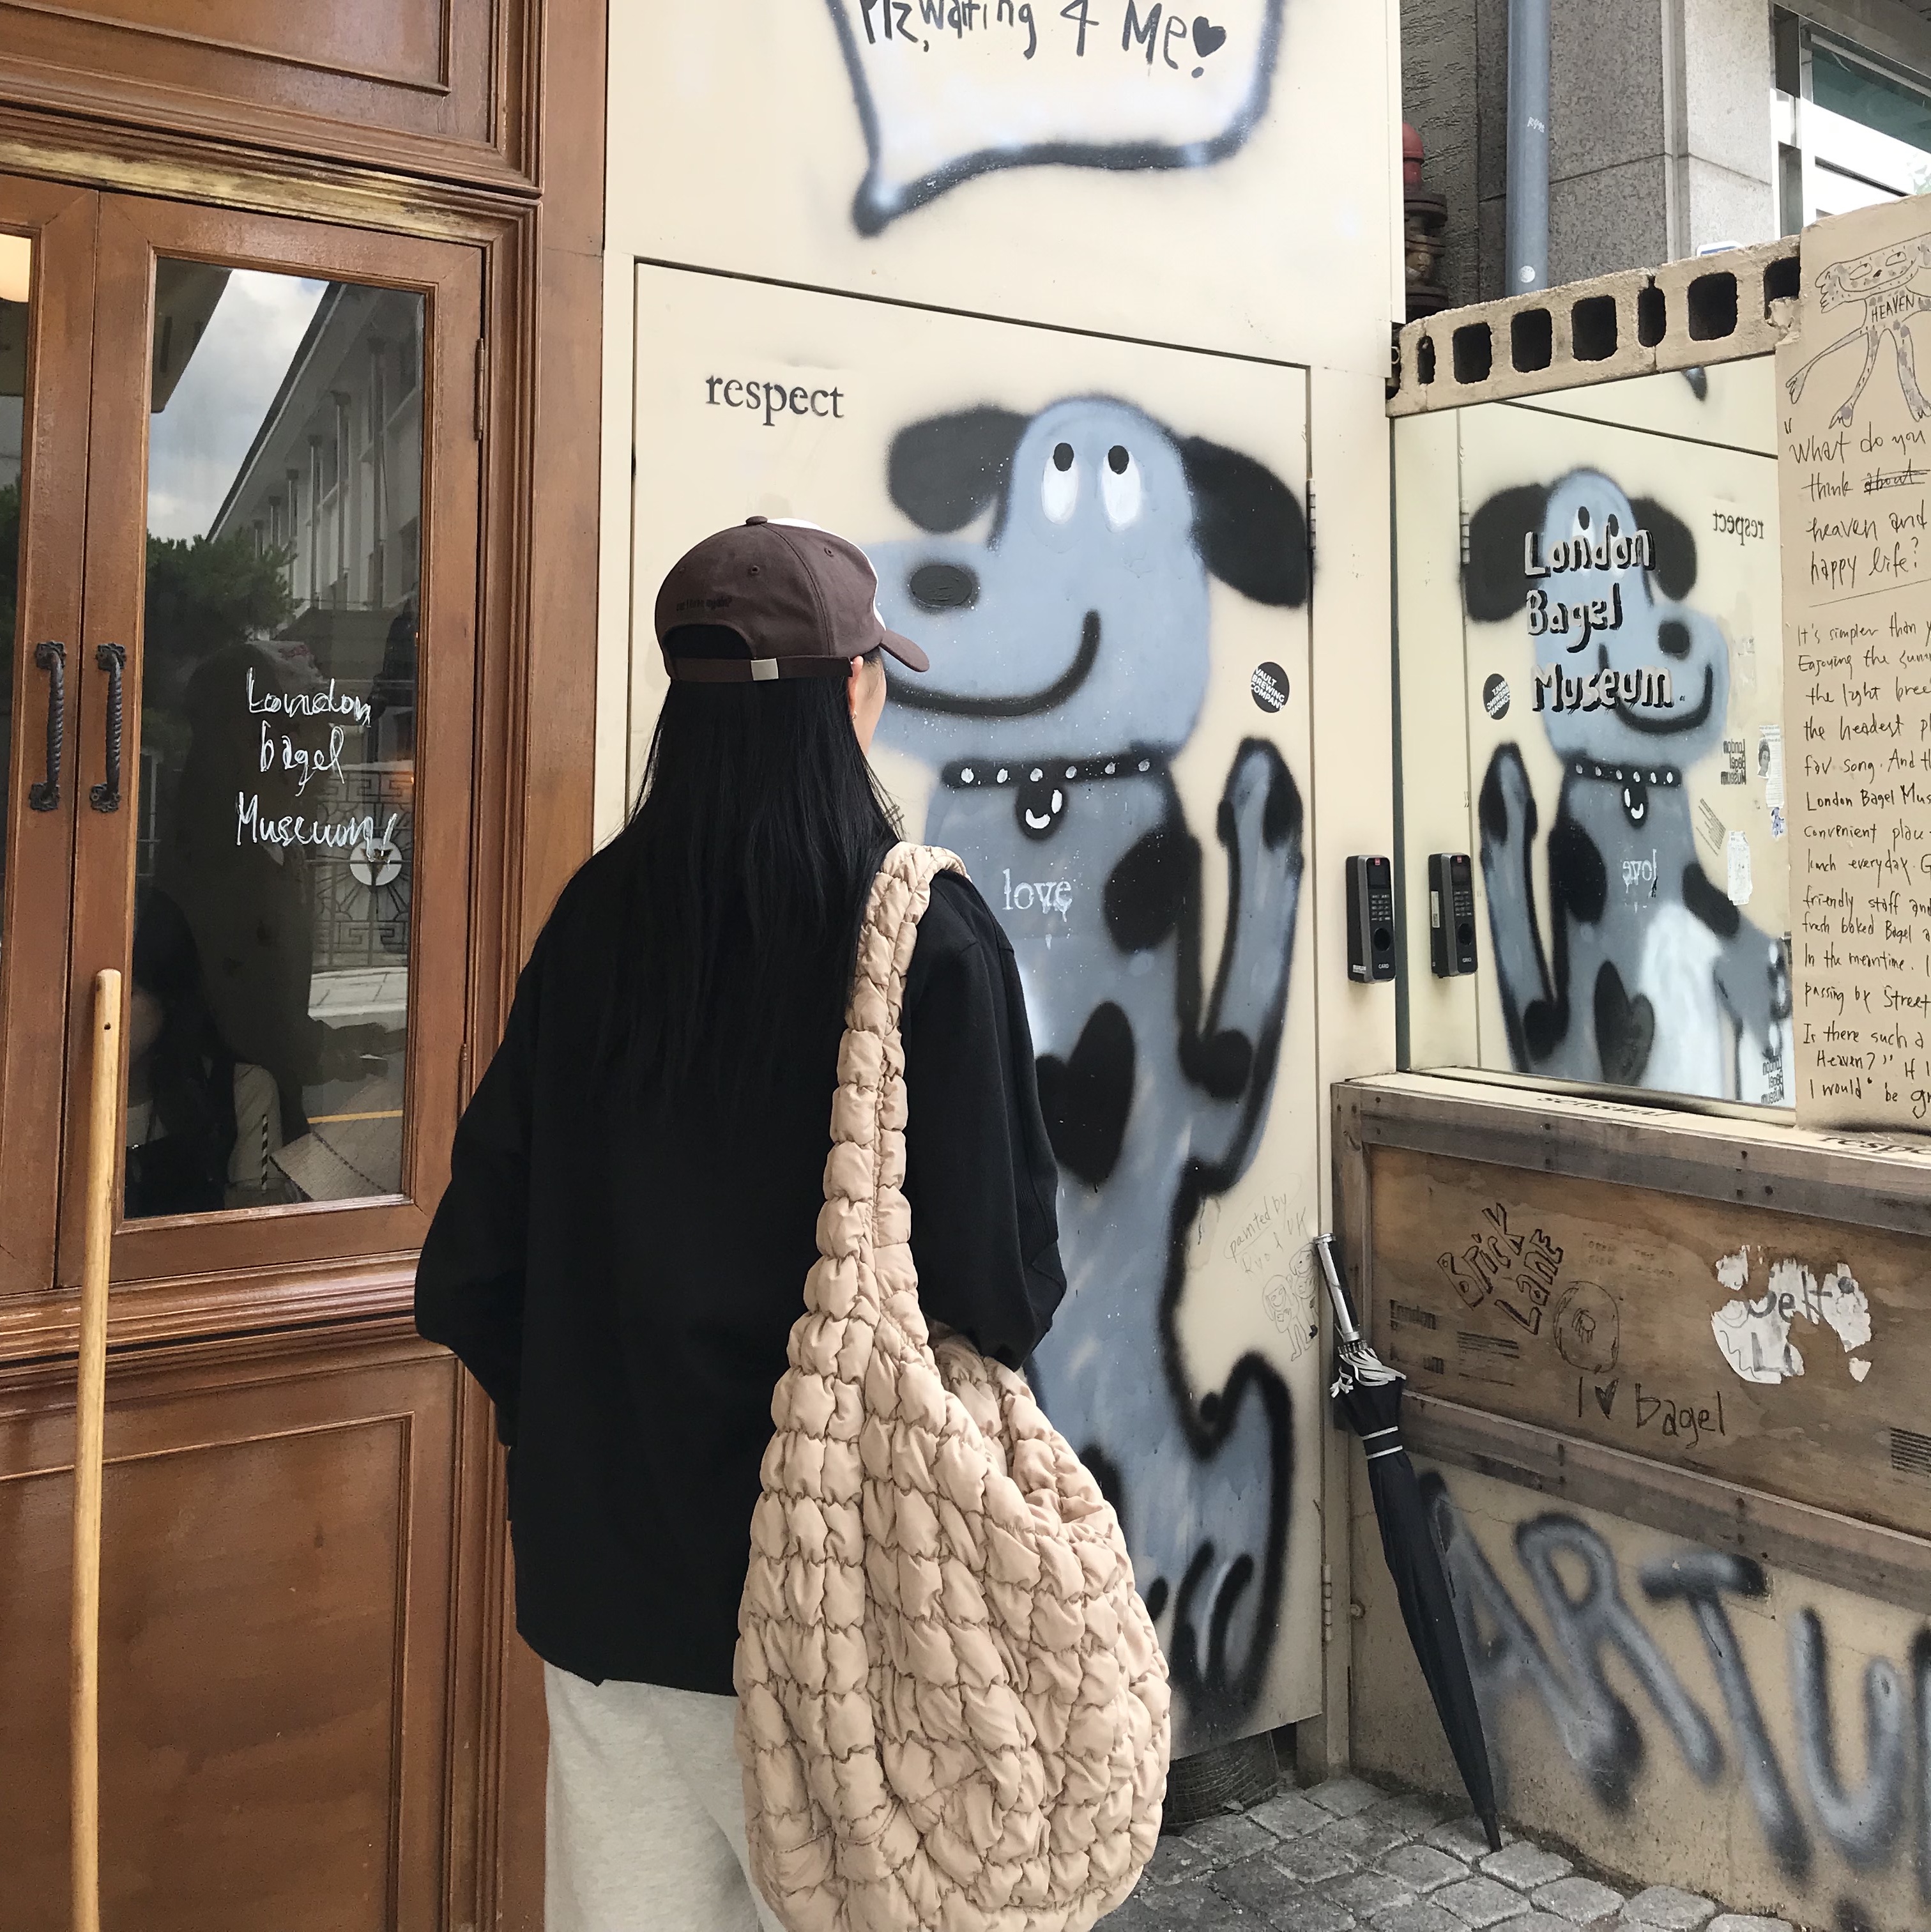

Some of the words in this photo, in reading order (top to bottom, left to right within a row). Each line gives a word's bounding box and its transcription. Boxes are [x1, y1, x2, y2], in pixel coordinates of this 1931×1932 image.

[1871, 294, 1914, 323] HEAVEN
[705, 374, 845, 427] respect
[1860, 421, 1884, 453] do
[1891, 431, 1926, 456] you
[1801, 471, 1854, 502] think
[1806, 517, 1878, 542] heaven
[1889, 500, 1928, 533] and
[1524, 528, 1656, 578] London
[1811, 551, 1857, 590] happy
[1525, 582, 1623, 653] Bagel
[1797, 624, 1820, 647] It's
[1829, 624, 1879, 646] simpler
[1889, 611, 1916, 638] than
[1863, 645, 1890, 668] the
[1252, 674, 1285, 703] BREWING
[1255, 666, 1277, 687] VAULT
[1806, 683, 1835, 705] the
[1843, 682, 1881, 707] light
[1895, 676, 1931, 702] bree
[247, 667, 372, 727] London
[1251, 682, 1285, 710] COMPANY
[1803, 716, 1826, 741] the
[1887, 748, 1916, 772] And
[1806, 792, 1853, 811] London
[1860, 788, 1895, 809] Bagel
[1002, 868, 1073, 915] love
[1805, 942, 1815, 968] In
[1824, 941, 1842, 969] the
[1855, 985, 1871, 1014] by
[1883, 985, 1931, 1019] Street
[1803, 1023, 1816, 1044] Is
[1823, 1020, 1859, 1043] there
[1870, 1022, 1907, 1049] such
[1810, 1078, 1814, 1099] I
[1884, 1082, 1898, 1102] be
[1230, 1195, 1271, 1264] painted
[1634, 1382, 1726, 1450] bagel
